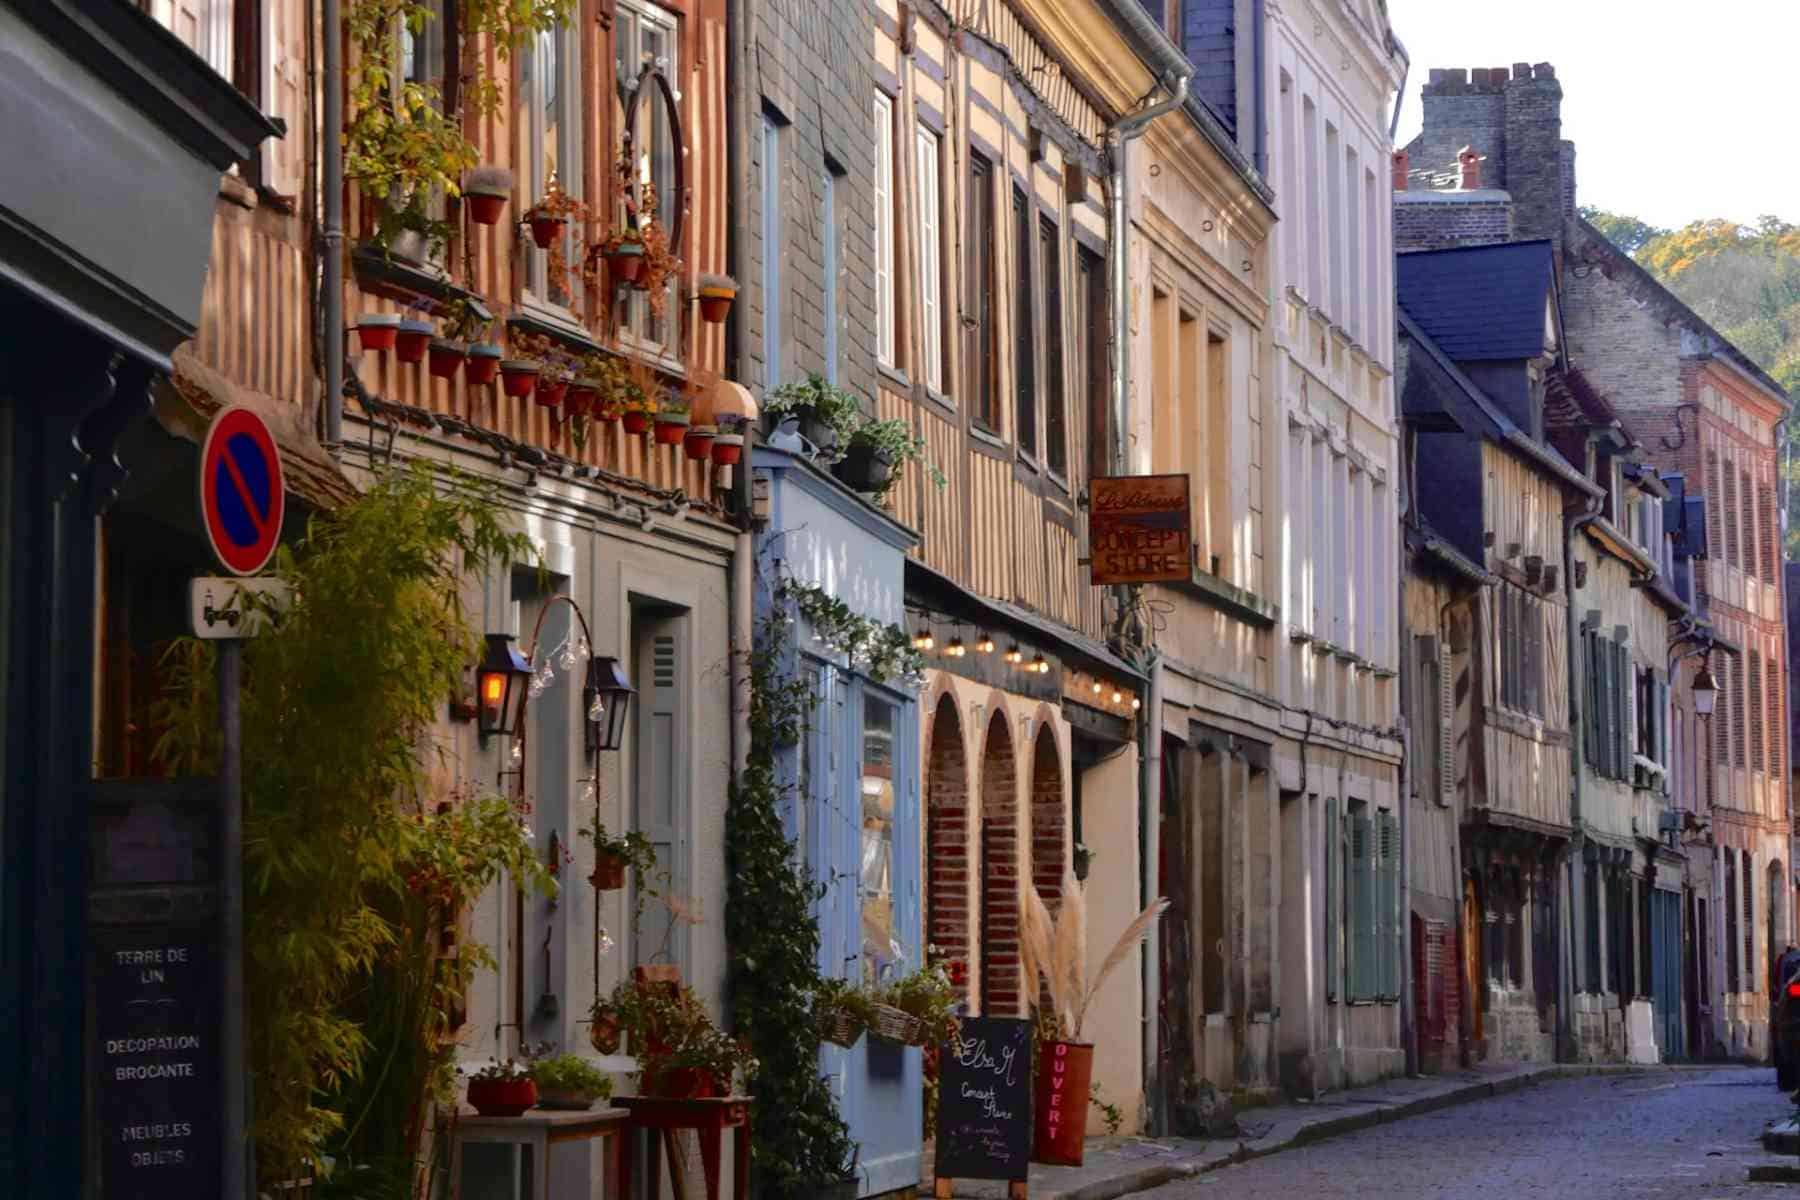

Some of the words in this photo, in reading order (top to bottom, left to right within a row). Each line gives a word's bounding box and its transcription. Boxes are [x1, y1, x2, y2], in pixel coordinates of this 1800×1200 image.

[1094, 529, 1187, 554] CONCEPT
[1105, 552, 1178, 576] STORE
[115, 949, 163, 965] TERRE
[167, 948, 188, 963] DE
[141, 969, 164, 984] LIN
[115, 1062, 194, 1081] BROCANTE
[1049, 1044, 1067, 1139] OUVERT
[121, 1122, 191, 1142] MEUBLES
[131, 1149, 184, 1168] OBJETS
